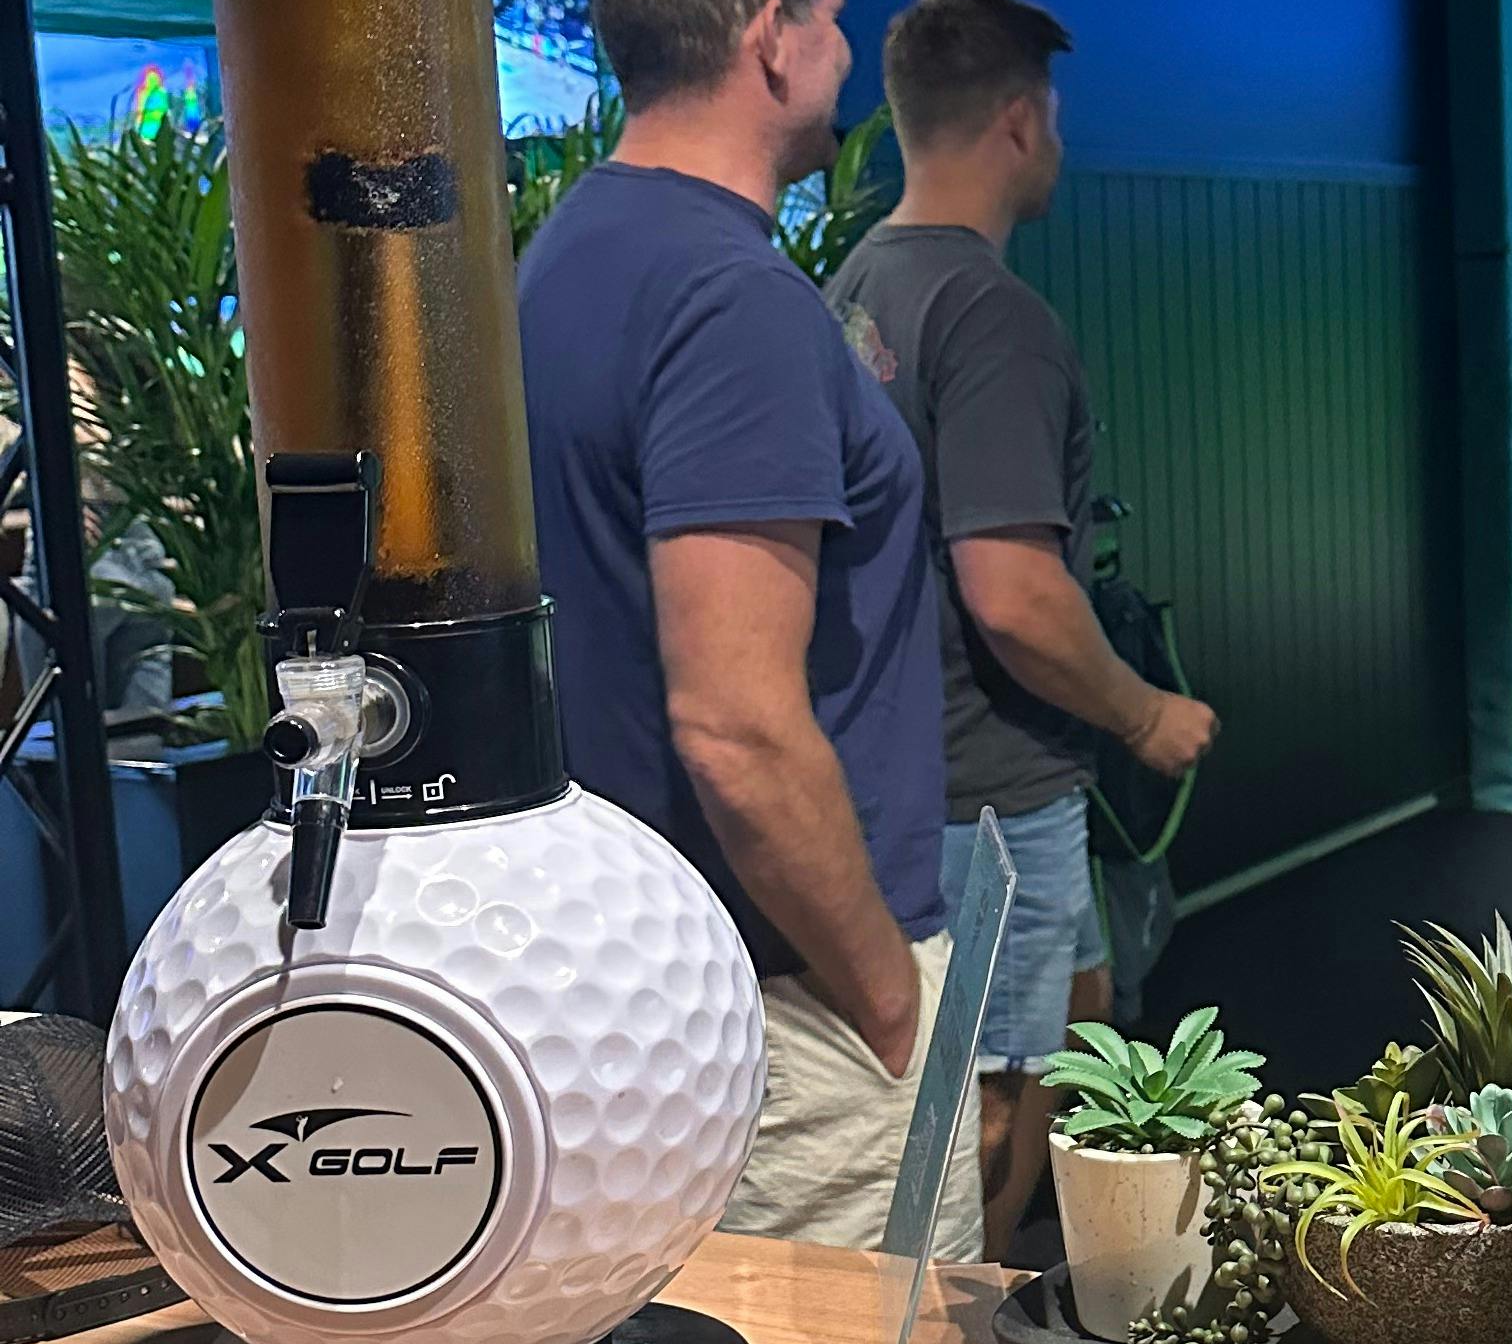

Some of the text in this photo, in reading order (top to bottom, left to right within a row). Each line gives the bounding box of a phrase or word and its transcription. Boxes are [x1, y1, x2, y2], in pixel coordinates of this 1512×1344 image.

[380, 785, 413, 795] UNLOCK
[208, 1142, 480, 1184] X GOLF
